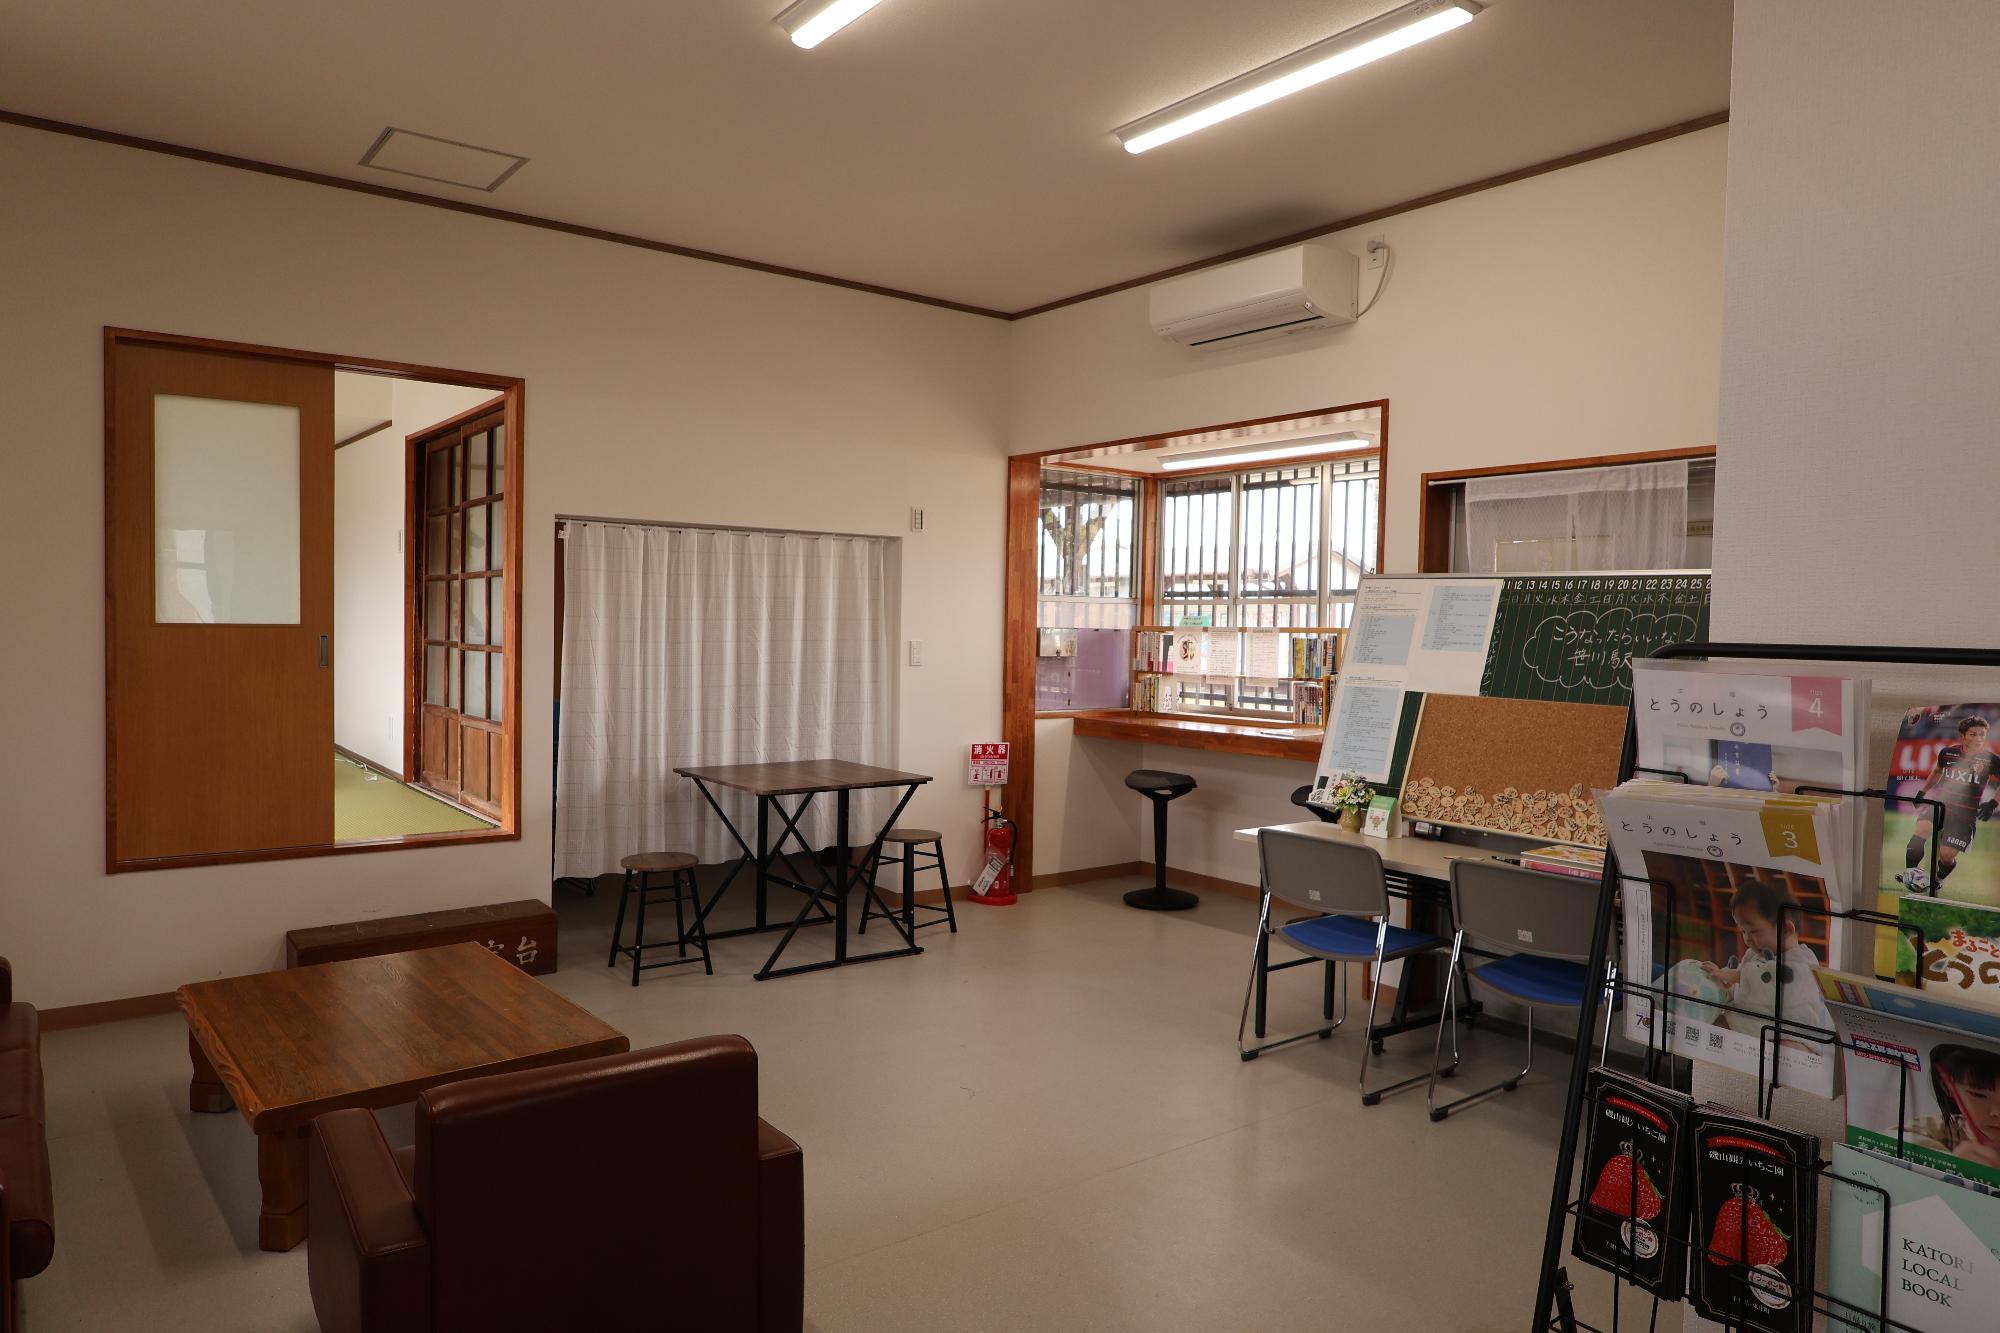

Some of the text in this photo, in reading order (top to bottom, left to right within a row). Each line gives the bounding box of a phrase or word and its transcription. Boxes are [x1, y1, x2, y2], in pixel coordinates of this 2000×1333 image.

[1514, 580, 1523, 590] 12
[1526, 580, 1536, 590] 13
[1538, 580, 1548, 590] 14
[1551, 580, 1561, 590] 15
[1564, 580, 1574, 590] 16
[1577, 580, 1588, 590] 17
[1590, 579, 1601, 590] 18
[1604, 579, 1615, 590] 19
[1617, 579, 1630, 590] 20
[1631, 579, 1643, 590] 21
[1645, 579, 1658, 590] 22
[1660, 578, 1673, 590] 23
[1674, 578, 1688, 590] 24
[1690, 578, 1703, 590] 25
[1560, 593, 1570, 605] 木
[1573, 592, 1585, 604] 金
[1603, 594, 1612, 604] 日
[1615, 593, 1624, 605] 月
[1553, 625, 1677, 645] こうなったらいいな
[1567, 648, 1632, 670] 笹川駅
[1649, 697, 1768, 720] とうのしょう
[1808, 697, 1824, 718] 4
[974, 744, 1007, 755] 消火器
[1621, 820, 1742, 846] とうのしょう
[1782, 830, 1799, 849] 3
[1950, 929, 2000, 958] まるごと
[1901, 1238, 1975, 1275] KATORI
[1901, 1258, 1965, 1292] LOCAL
[1901, 1278, 1953, 1308] BOOK
